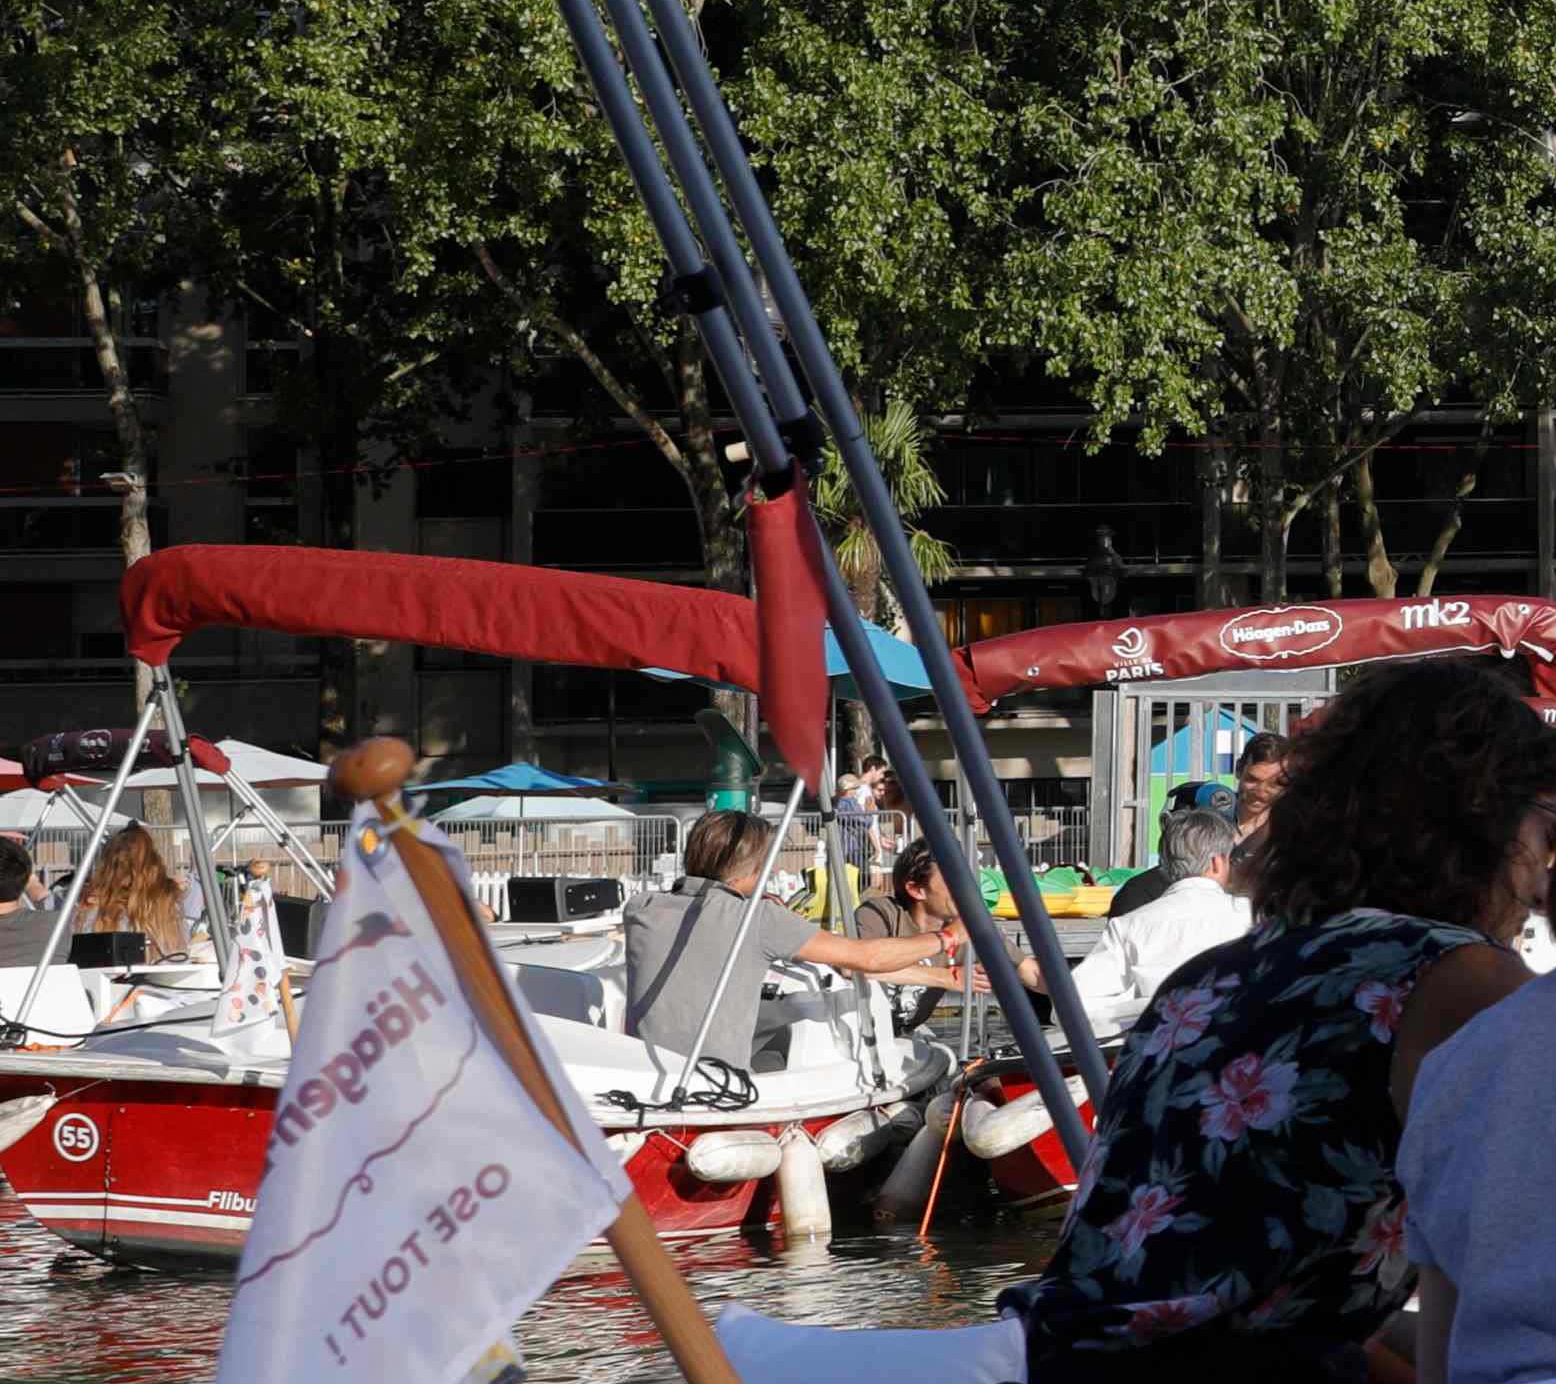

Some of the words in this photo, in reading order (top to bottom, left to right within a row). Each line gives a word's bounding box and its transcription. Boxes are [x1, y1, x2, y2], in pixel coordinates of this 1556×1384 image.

[1400, 599, 1472, 630] mk2
[1232, 619, 1330, 644] Häagen-Dazs
[1106, 661, 1164, 682] PARIS
[61, 1125, 91, 1149] 55
[207, 1191, 258, 1212] Flibu
